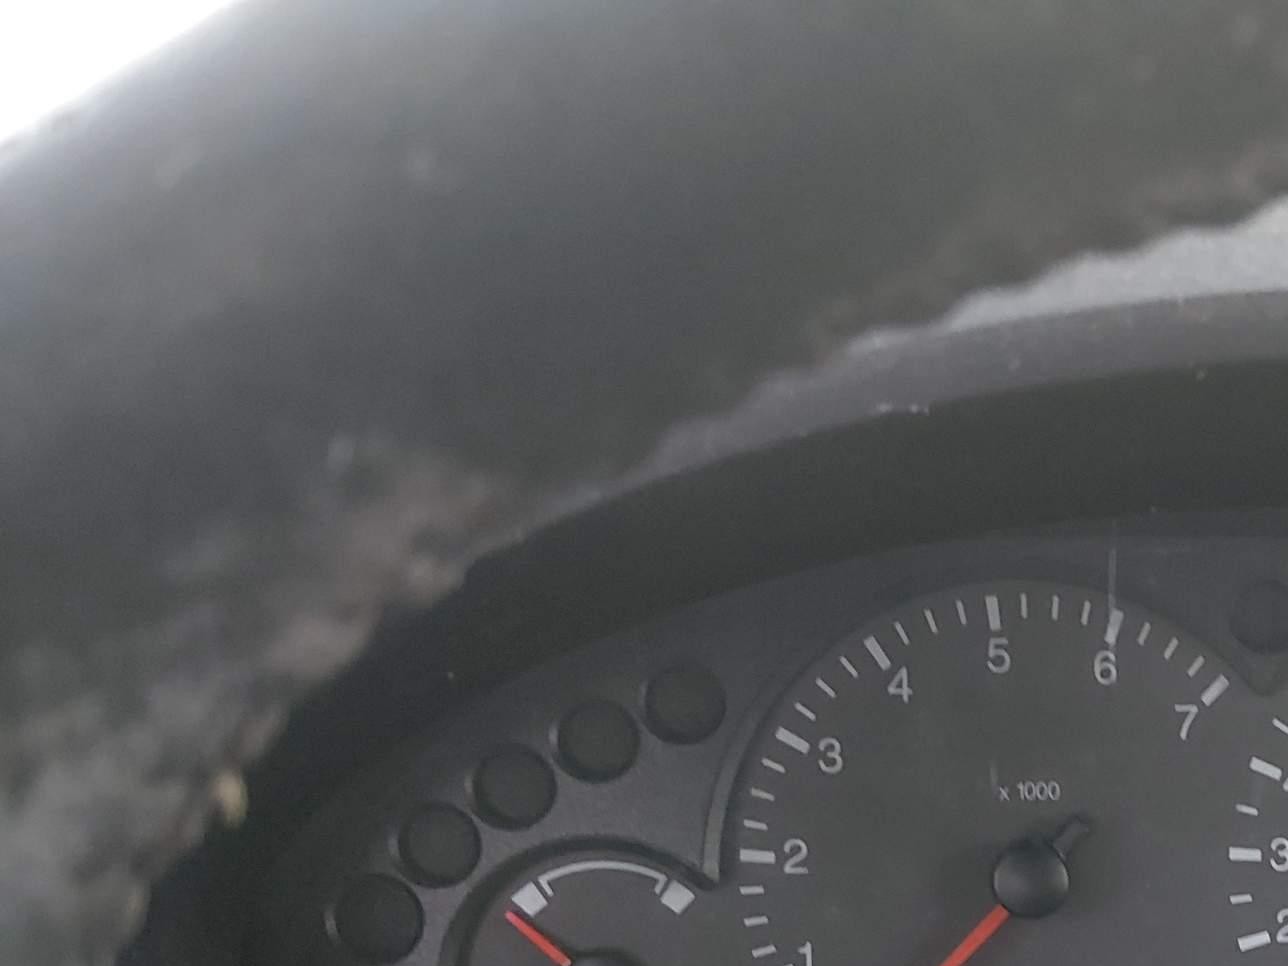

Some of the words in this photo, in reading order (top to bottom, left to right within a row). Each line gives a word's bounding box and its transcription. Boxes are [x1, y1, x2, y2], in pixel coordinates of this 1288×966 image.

[987, 639, 1011, 673] 5
[1094, 651, 1116, 685] 6
[887, 668, 913, 702] 4
[1174, 703, 1199, 740] 7
[818, 738, 843, 773] 3
[1018, 781, 1060, 800] 1000
[783, 840, 808, 874] 2
